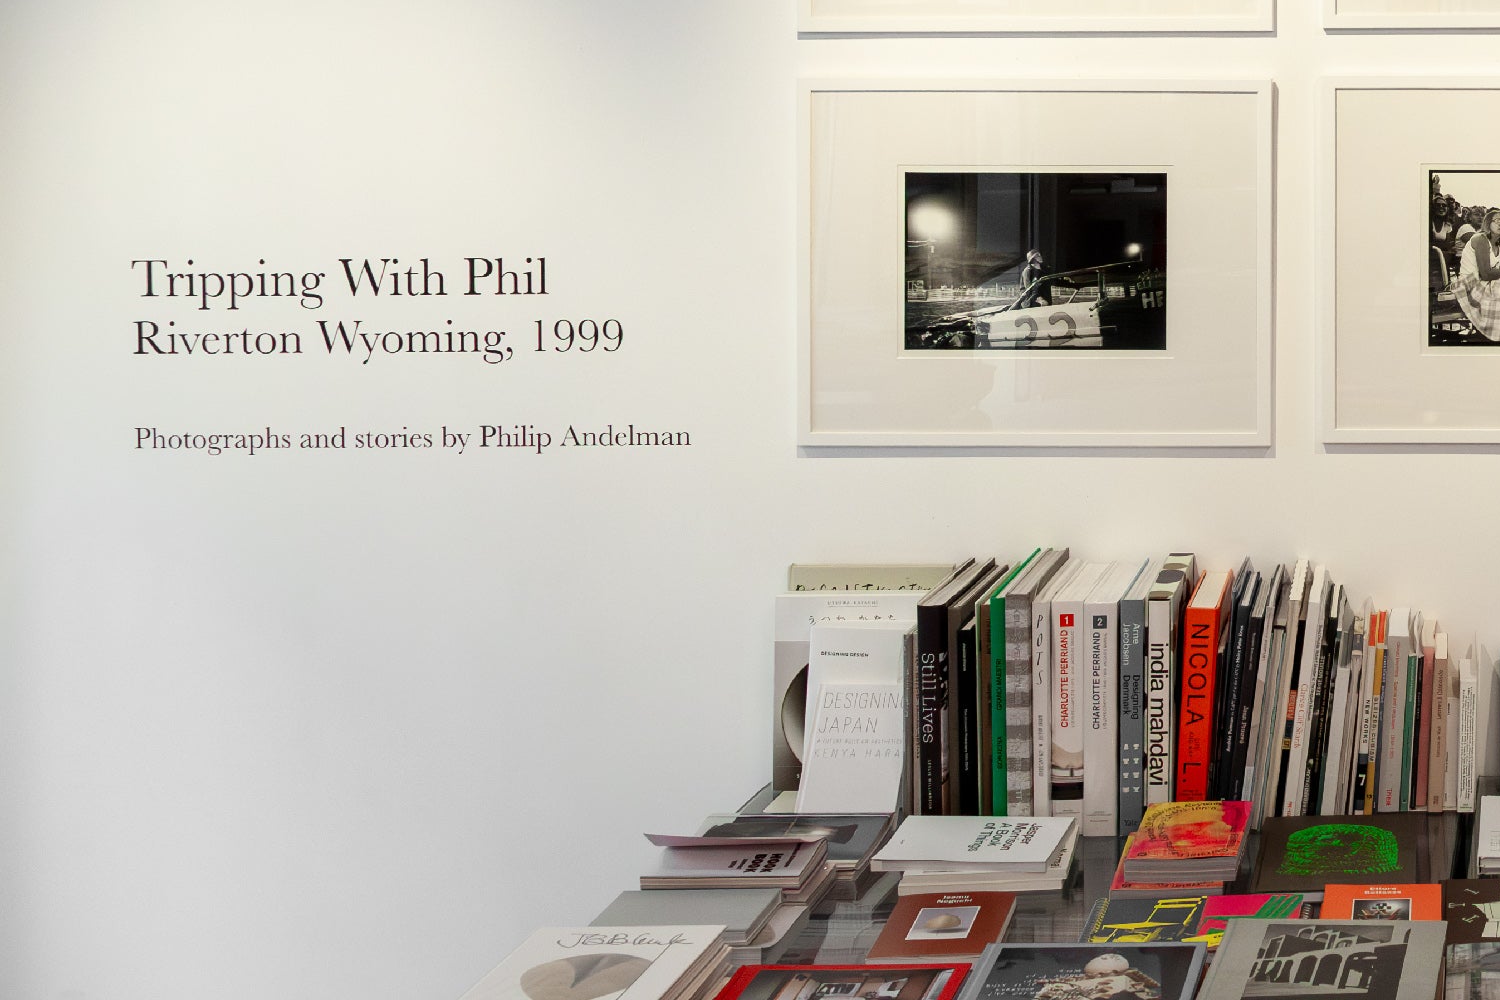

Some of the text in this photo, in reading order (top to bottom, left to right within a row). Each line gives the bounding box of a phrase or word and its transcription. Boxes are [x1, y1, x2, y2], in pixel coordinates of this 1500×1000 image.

[132, 256, 550, 310] Tripping With Phil
[132, 318, 624, 365] Riverton Wyoming, 1999
[133, 425, 692, 456] Photographs and stories by Philip Andelman
[1063, 615, 1071, 626] 1
[1097, 616, 1105, 627] 2
[1060, 630, 1070, 728] CHARLOTTE PERRIAND
[1092, 632, 1101, 730] CHARLOTTE PERRIAND
[1122, 622, 1131, 716] Jacobsen Denmark
[1131, 622, 1141, 720] Arne Designing
[921, 652, 937, 744] Still Lives
[1150, 643, 1169, 786] india mahdavi
[1183, 623, 1210, 784] NICOLA L.
[818, 716, 879, 734] JAPAN
[1362, 699, 1372, 745] NEW WORKS
[987, 829, 1008, 847] Book
[1000, 822, 1030, 851] Morrison
[1020, 822, 1043, 845] Jasper
